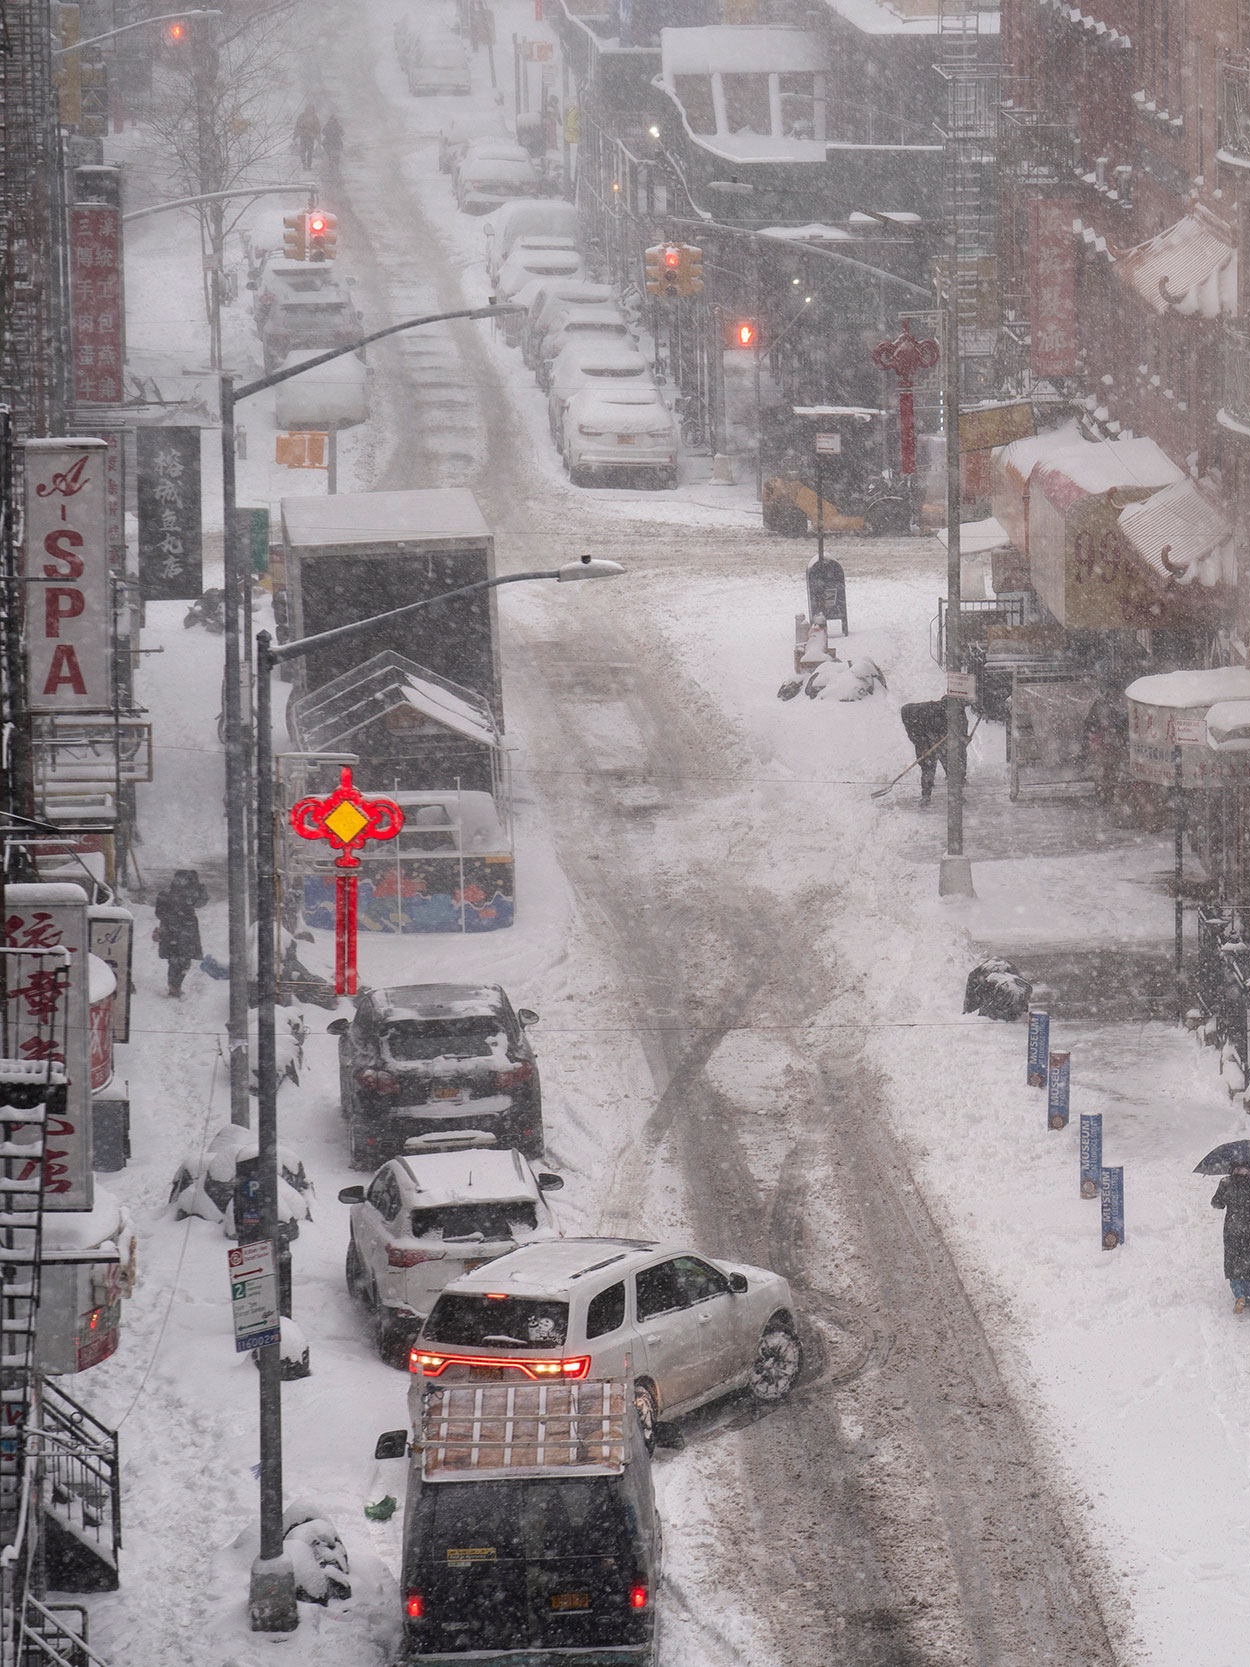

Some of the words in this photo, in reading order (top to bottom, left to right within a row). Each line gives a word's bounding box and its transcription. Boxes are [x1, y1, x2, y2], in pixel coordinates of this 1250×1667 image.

[1029, 1017, 1039, 1064] MUSEUM
[1050, 1063, 1059, 1106] MUSEU
[1081, 1120, 1090, 1170] MUSEUM
[1102, 1171, 1111, 1223] MUSEUM
[235, 1284, 244, 1299] 2
